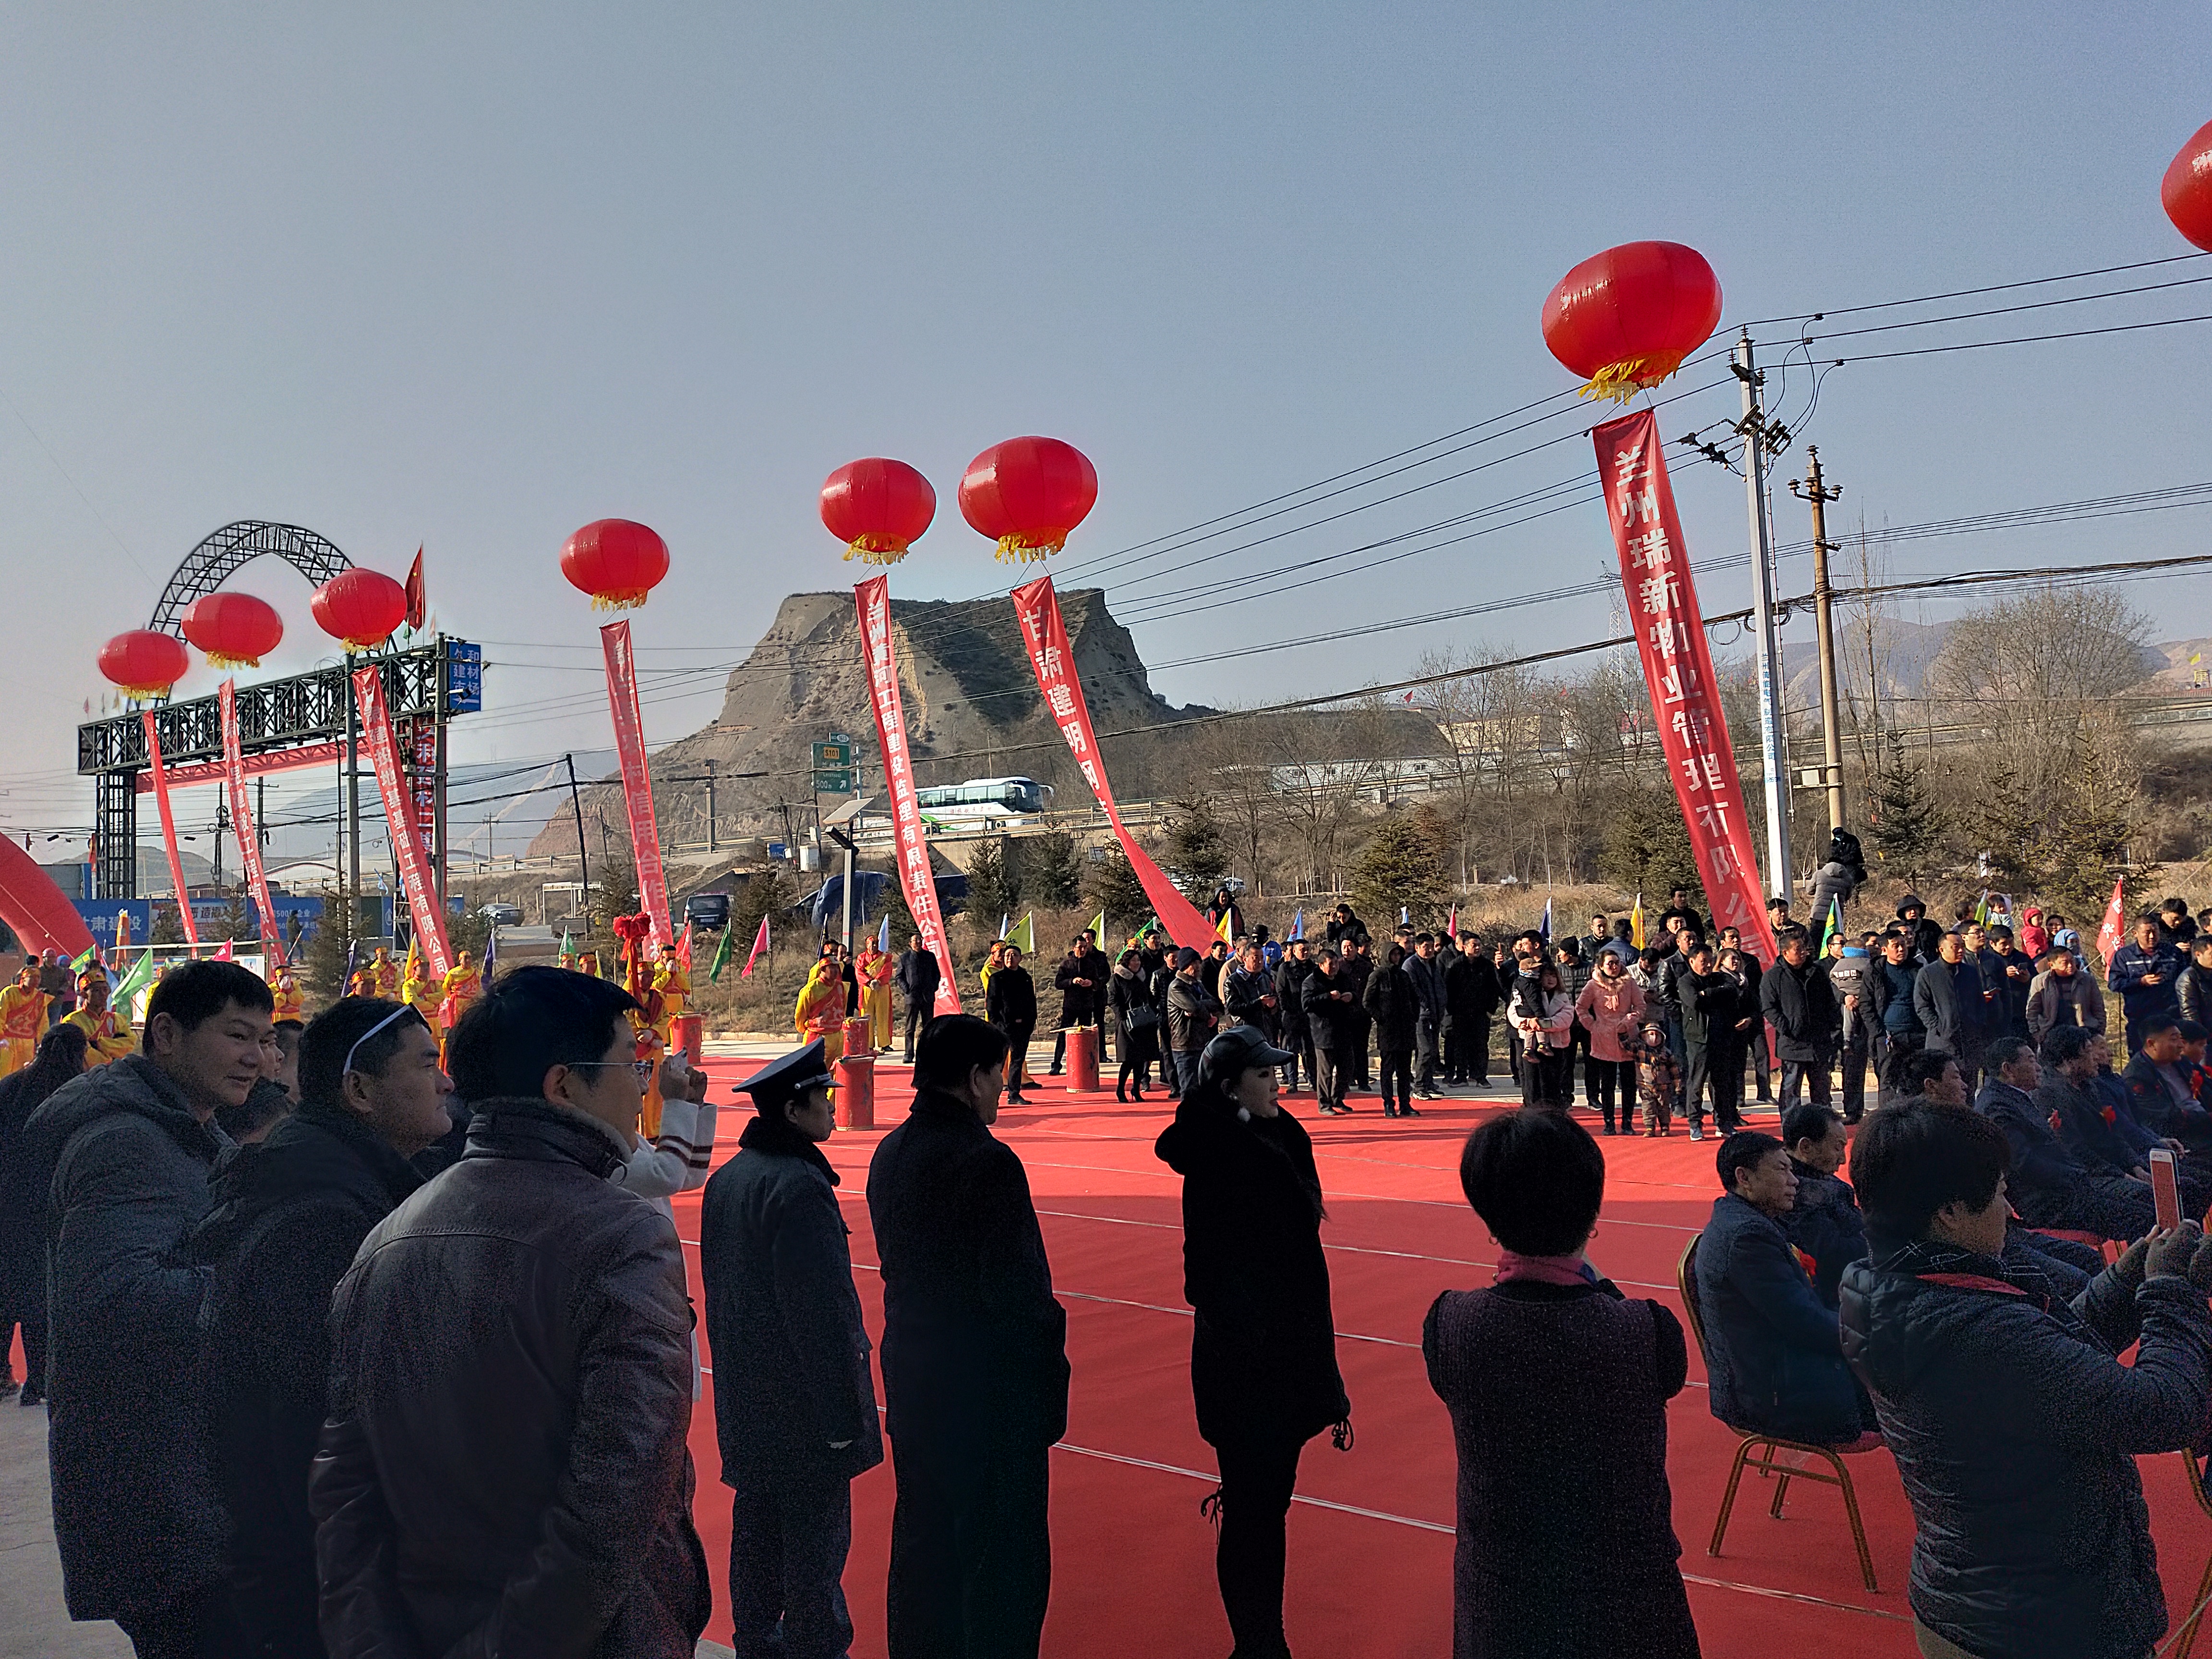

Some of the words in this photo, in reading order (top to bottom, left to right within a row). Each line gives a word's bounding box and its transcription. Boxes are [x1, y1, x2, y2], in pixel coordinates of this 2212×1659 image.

[453, 664, 480, 679] 建材
[866, 600, 943, 960] 兰州黄河工程建设监理有限责任公司
[1615, 445, 1772, 967] 兰州瑞新物业管理有限公司
[274, 909, 311, 918] 500企业
[361, 684, 449, 974] 甘肃建投地基基础工程有限公司
